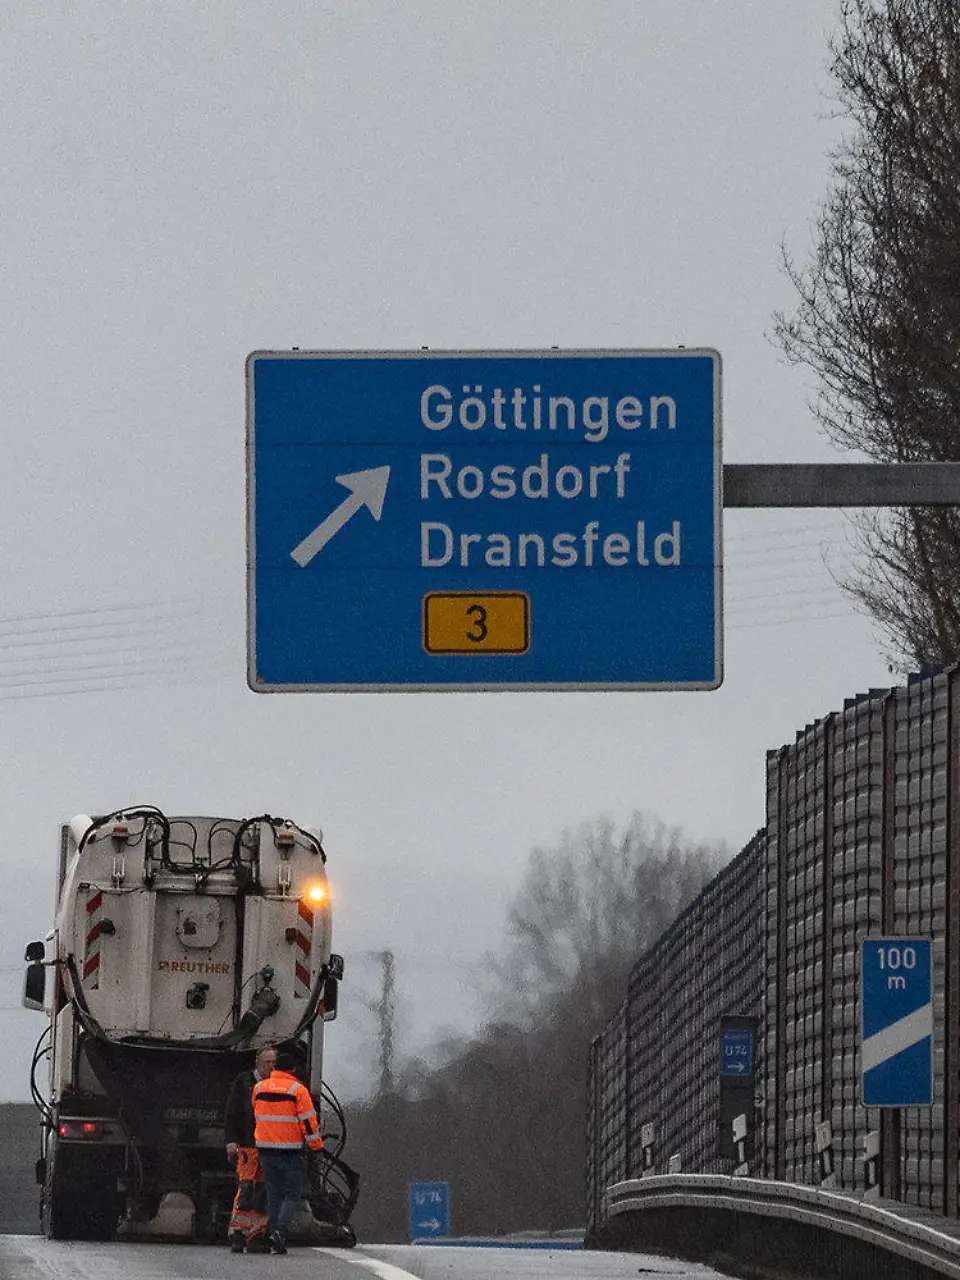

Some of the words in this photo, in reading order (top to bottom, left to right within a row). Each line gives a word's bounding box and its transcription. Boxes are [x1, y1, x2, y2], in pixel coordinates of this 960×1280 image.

[419, 384, 678, 443] Göttingen
[419, 452, 632, 500] Rosdorf
[419, 520, 682, 568] Dransfeld
[464, 604, 489, 643] 3
[171, 961, 230, 975] REUTHER
[877, 947, 916, 970] 100
[888, 975, 906, 990] m
